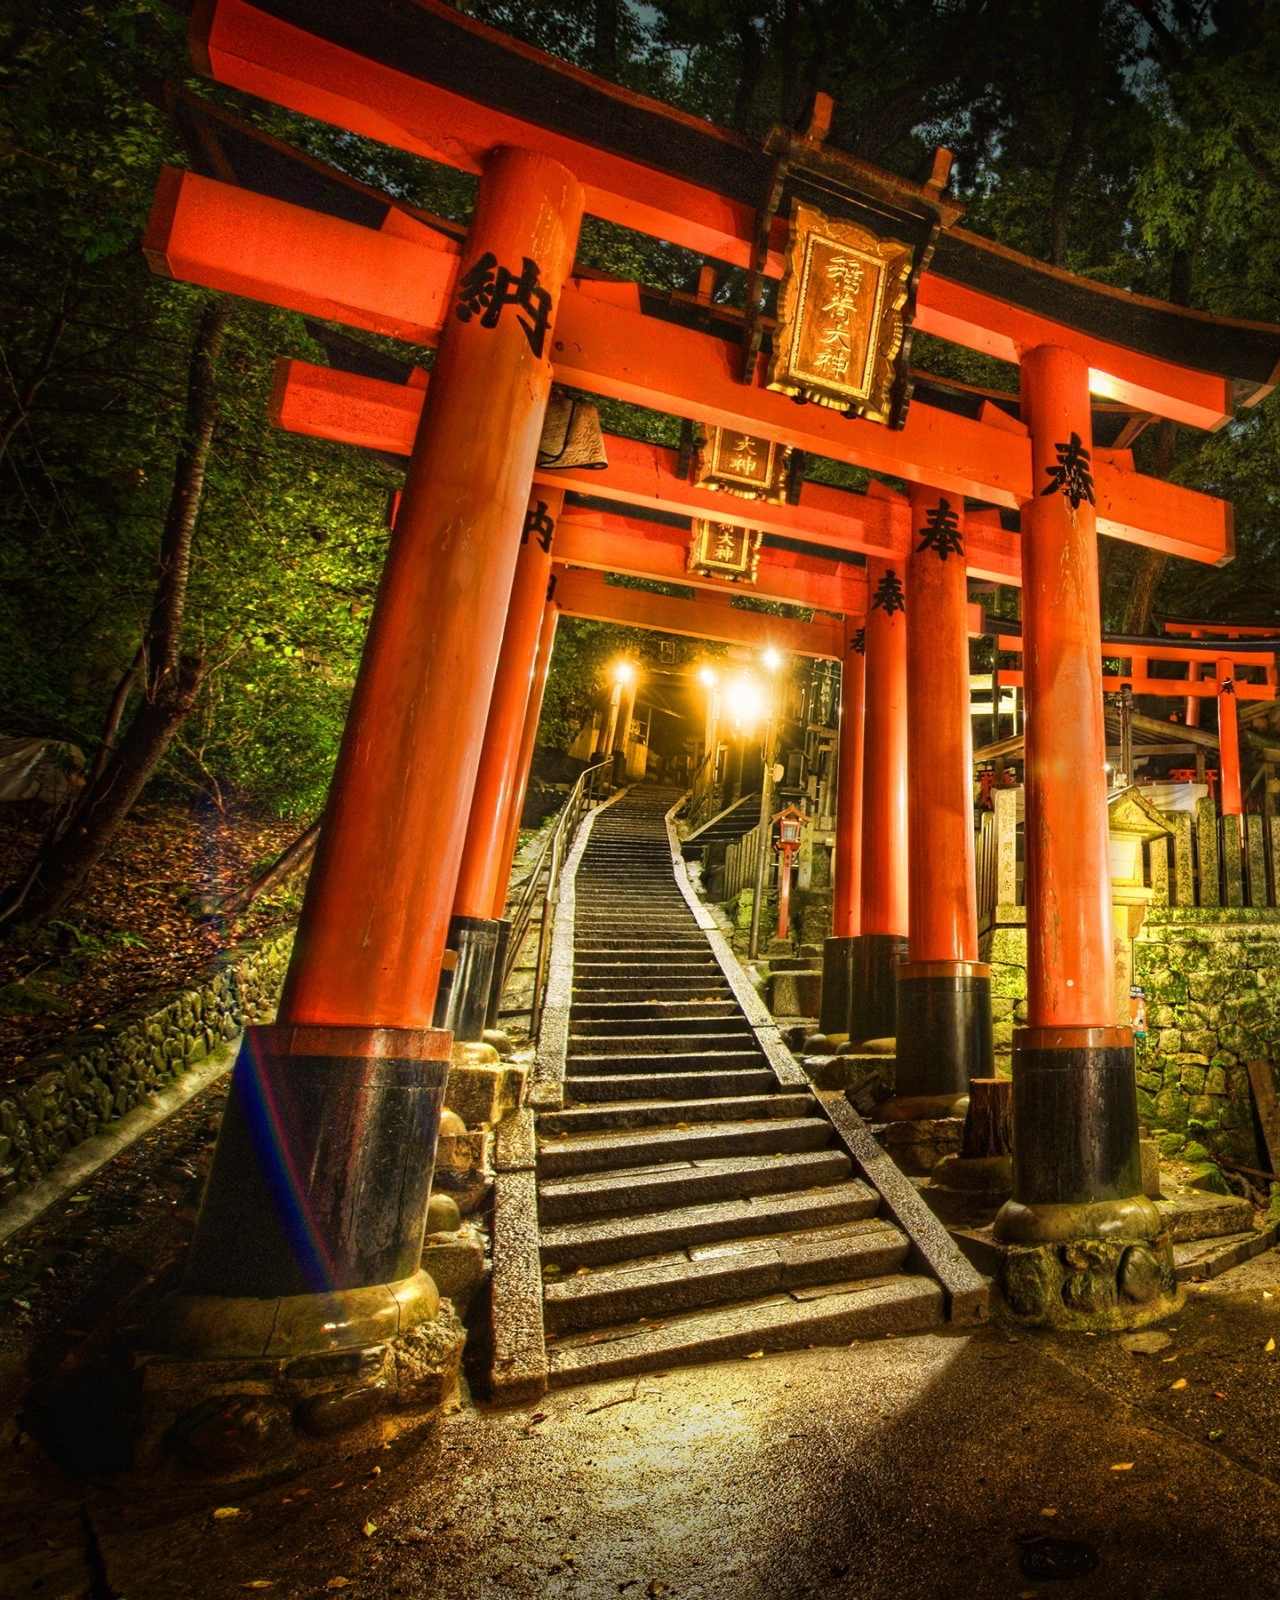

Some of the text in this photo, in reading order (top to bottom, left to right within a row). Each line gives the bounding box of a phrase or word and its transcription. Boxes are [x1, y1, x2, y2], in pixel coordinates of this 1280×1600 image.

[456, 251, 553, 360] 納
[1040, 431, 1096, 510] 奉
[915, 498, 965, 561] 奉
[871, 569, 906, 617] 奉
